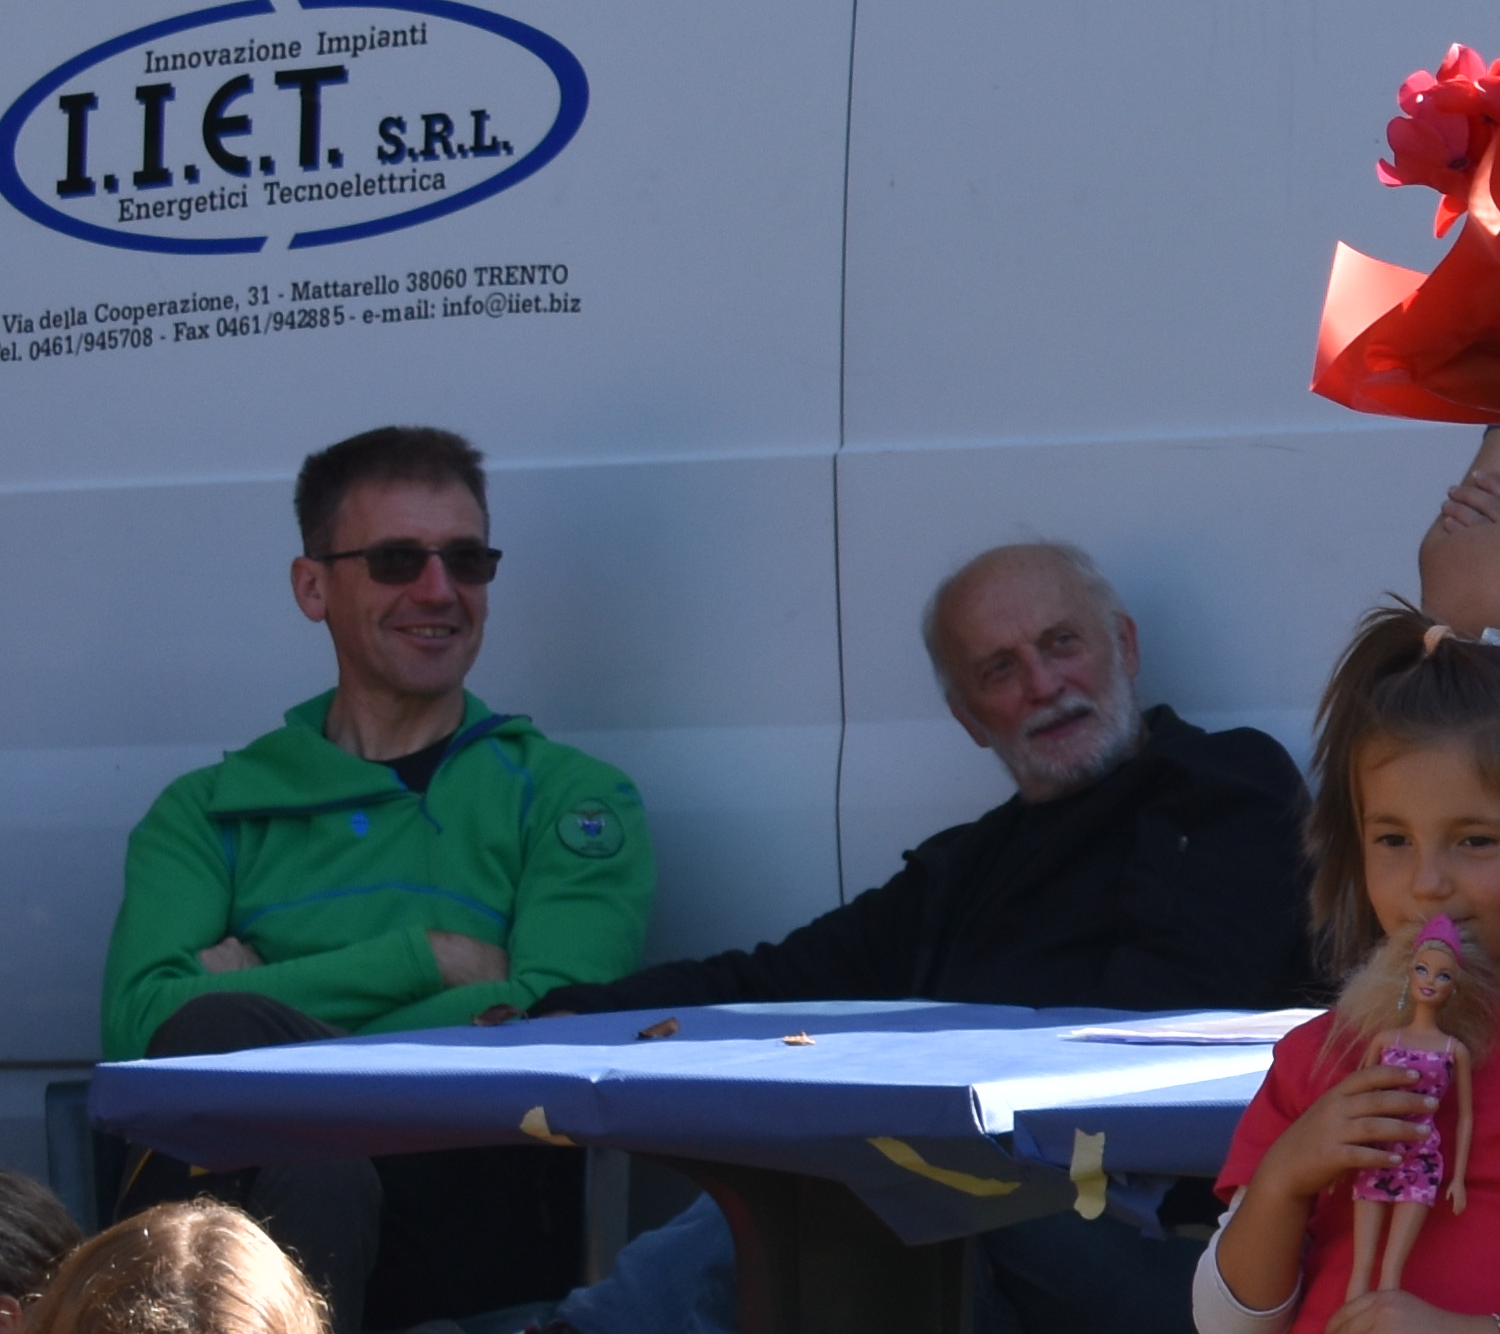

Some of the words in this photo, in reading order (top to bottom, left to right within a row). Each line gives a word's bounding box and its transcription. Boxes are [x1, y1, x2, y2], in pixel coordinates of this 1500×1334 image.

[145, 39, 302, 73] Innovazione
[317, 23, 428, 59] Impianti
[56, 65, 349, 198] I.I.E.T.
[377, 109, 514, 164] S.R.L.
[118, 188, 249, 223] Energetici
[263, 171, 446, 206] Tecnoelettrica
[0, 342, 23, 362] el.
[29, 327, 153, 360] 0461/945708
[173, 322, 210, 342] Fax
[216, 305, 345, 337] 0461/942885
[362, 300, 436, 325] e-mail:
[442, 291, 582, 318] info@iiet.biz
[3, 314, 34, 334] Via
[39, 307, 88, 330] della
[95, 292, 240, 325] Cooperazione,
[248, 285, 270, 306] 31
[291, 275, 400, 301] Mattarello
[406, 268, 467, 292] 38060
[474, 264, 569, 287] TRENTO
